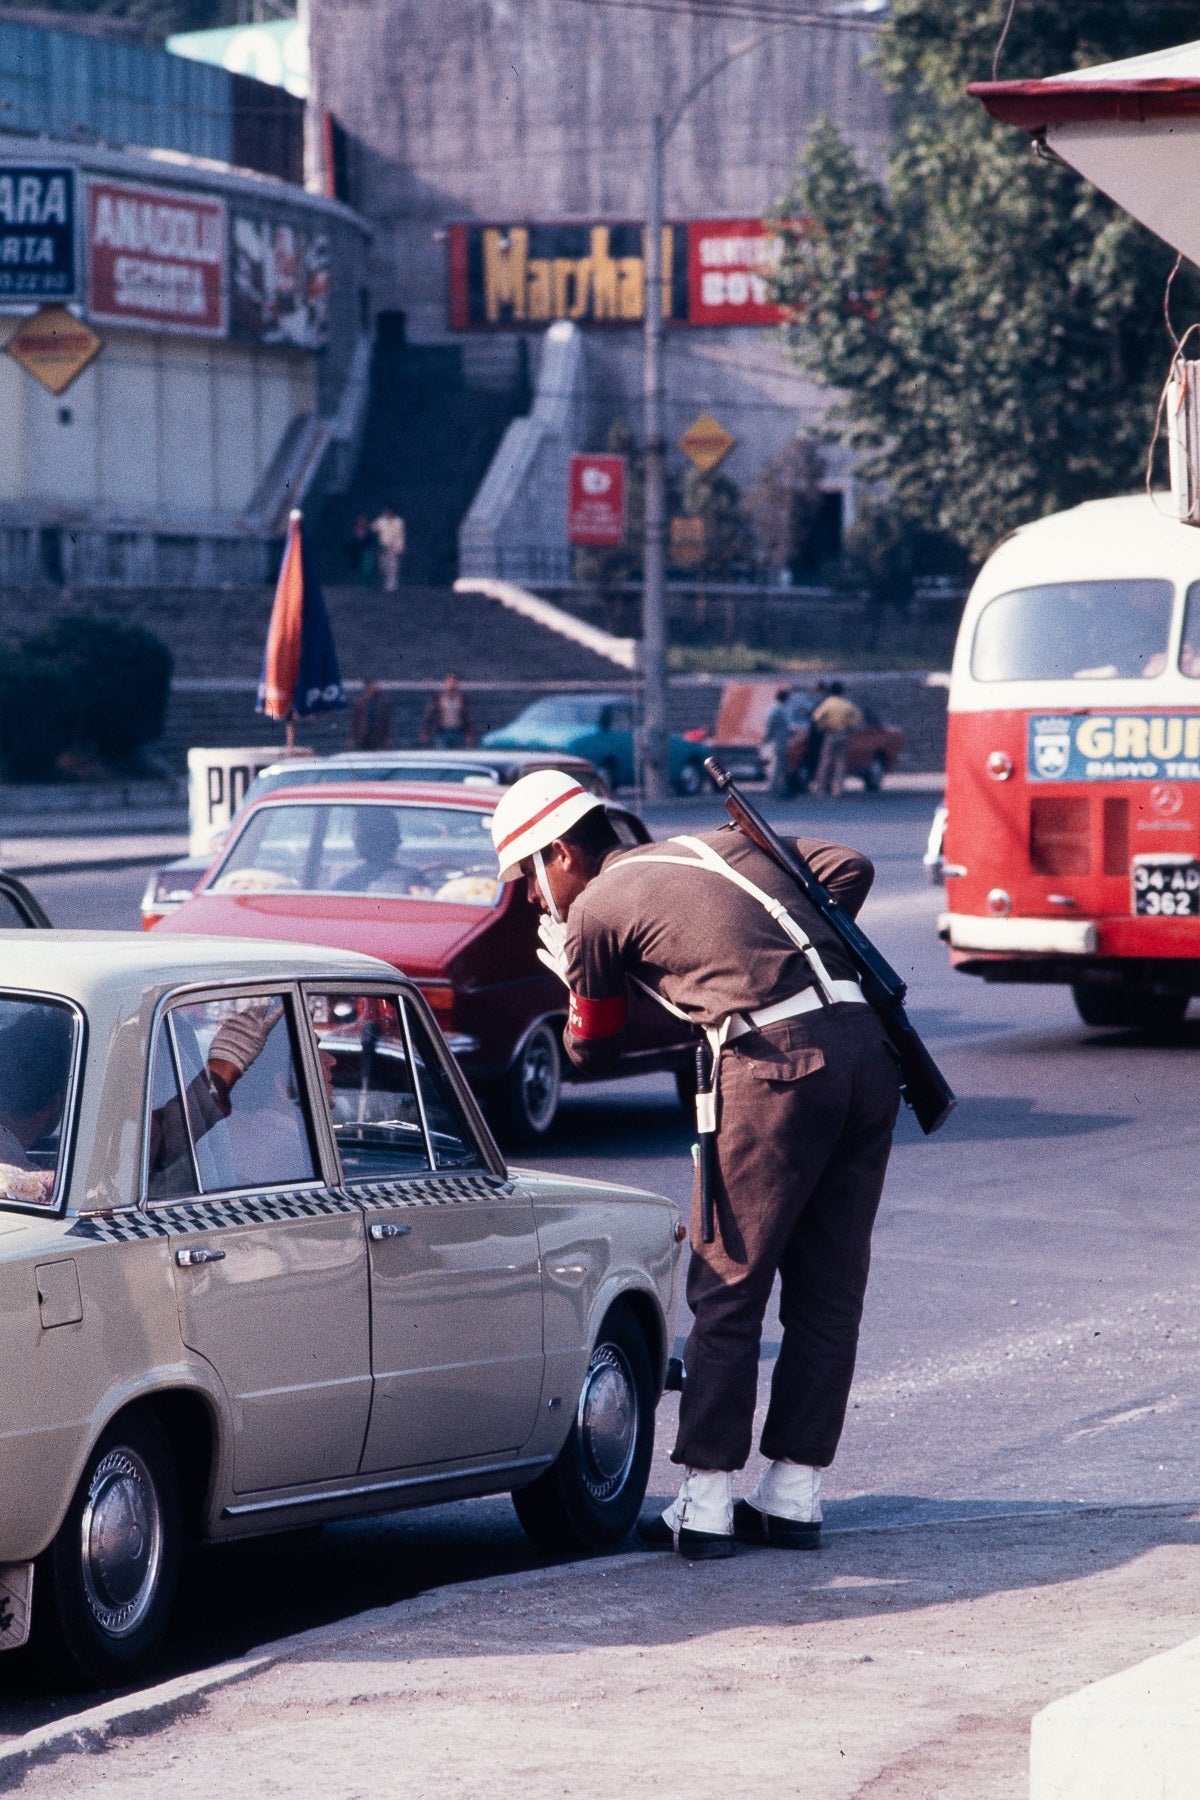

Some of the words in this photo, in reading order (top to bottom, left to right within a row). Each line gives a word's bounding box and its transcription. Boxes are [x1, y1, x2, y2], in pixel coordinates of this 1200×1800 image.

[0, 236, 55, 262] RTA
[207, 766, 272, 825] PO
[1146, 891, 1191, 915] 362
